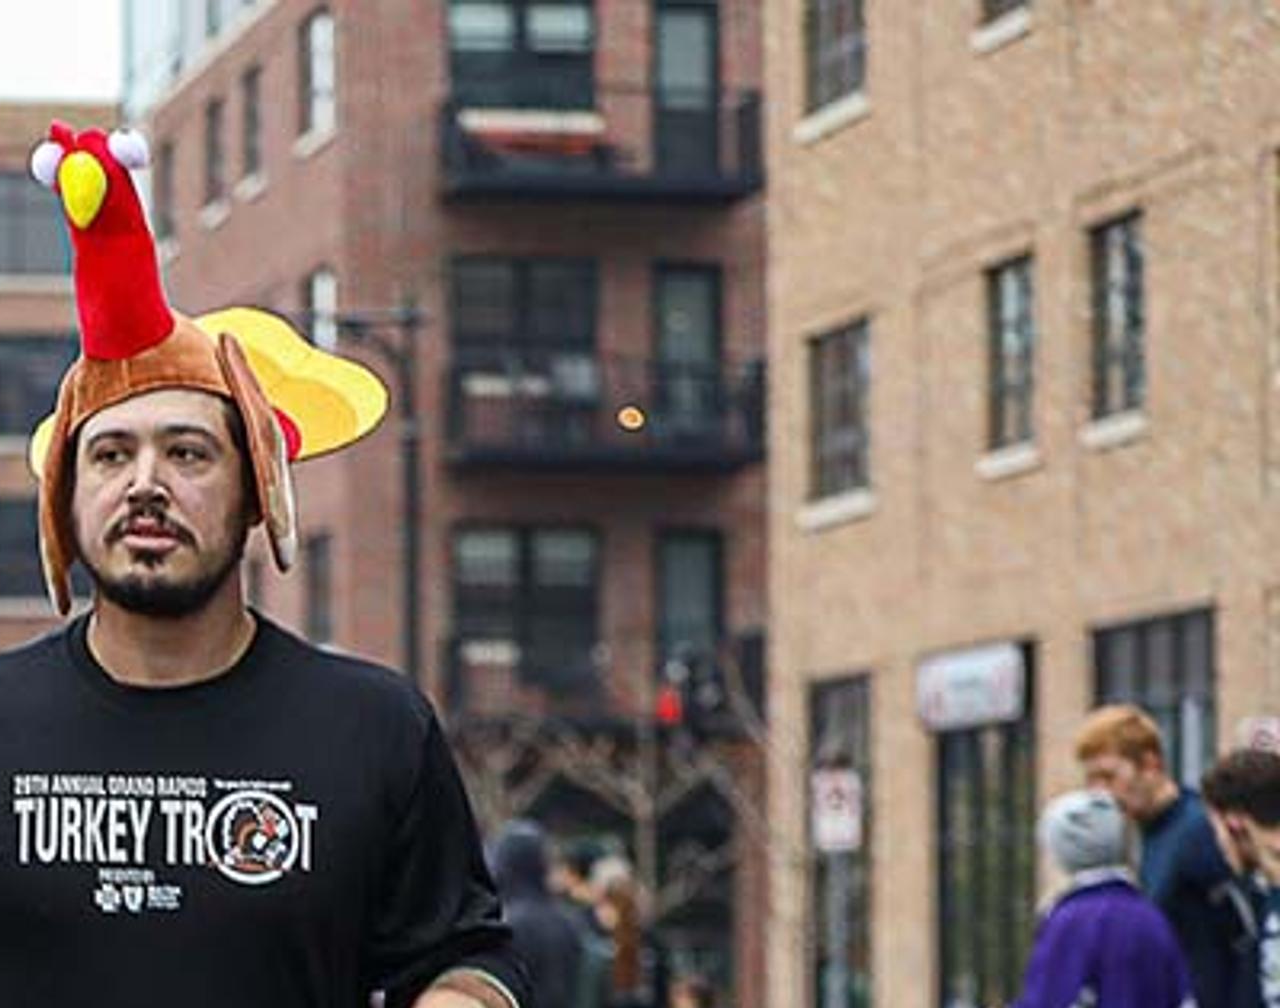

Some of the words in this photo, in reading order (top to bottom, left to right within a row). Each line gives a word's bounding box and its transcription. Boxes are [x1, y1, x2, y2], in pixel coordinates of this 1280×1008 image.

[51, 775, 107, 796] ANNUAL
[108, 776, 154, 797] GRAND
[157, 777, 207, 798] RAPIDS
[13, 797, 152, 864] TURKEY
[160, 790, 318, 885] TROT
